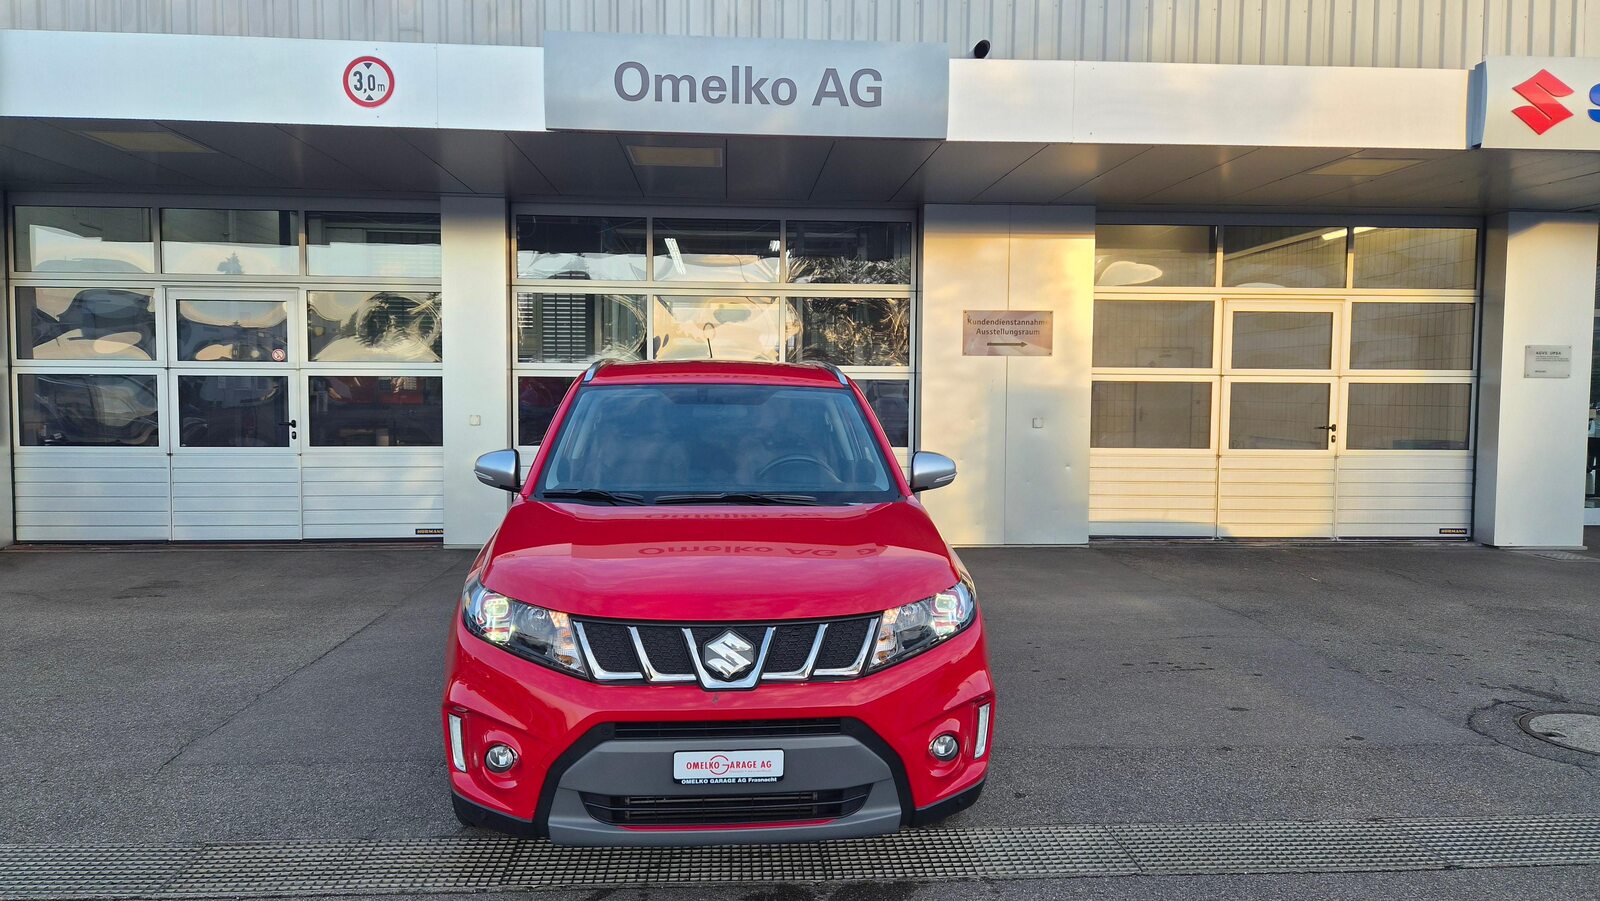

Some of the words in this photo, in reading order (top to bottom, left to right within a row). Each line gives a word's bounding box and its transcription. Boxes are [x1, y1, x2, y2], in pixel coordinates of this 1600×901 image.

[614, 61, 797, 106] Omelko
[812, 67, 882, 108] AG
[967, 317, 1047, 326] Kundendienstannahm
[976, 328, 1040, 336] Ausstellungsraum
[686, 761, 720, 770] OMELKO
[761, 760, 772, 769] AG
